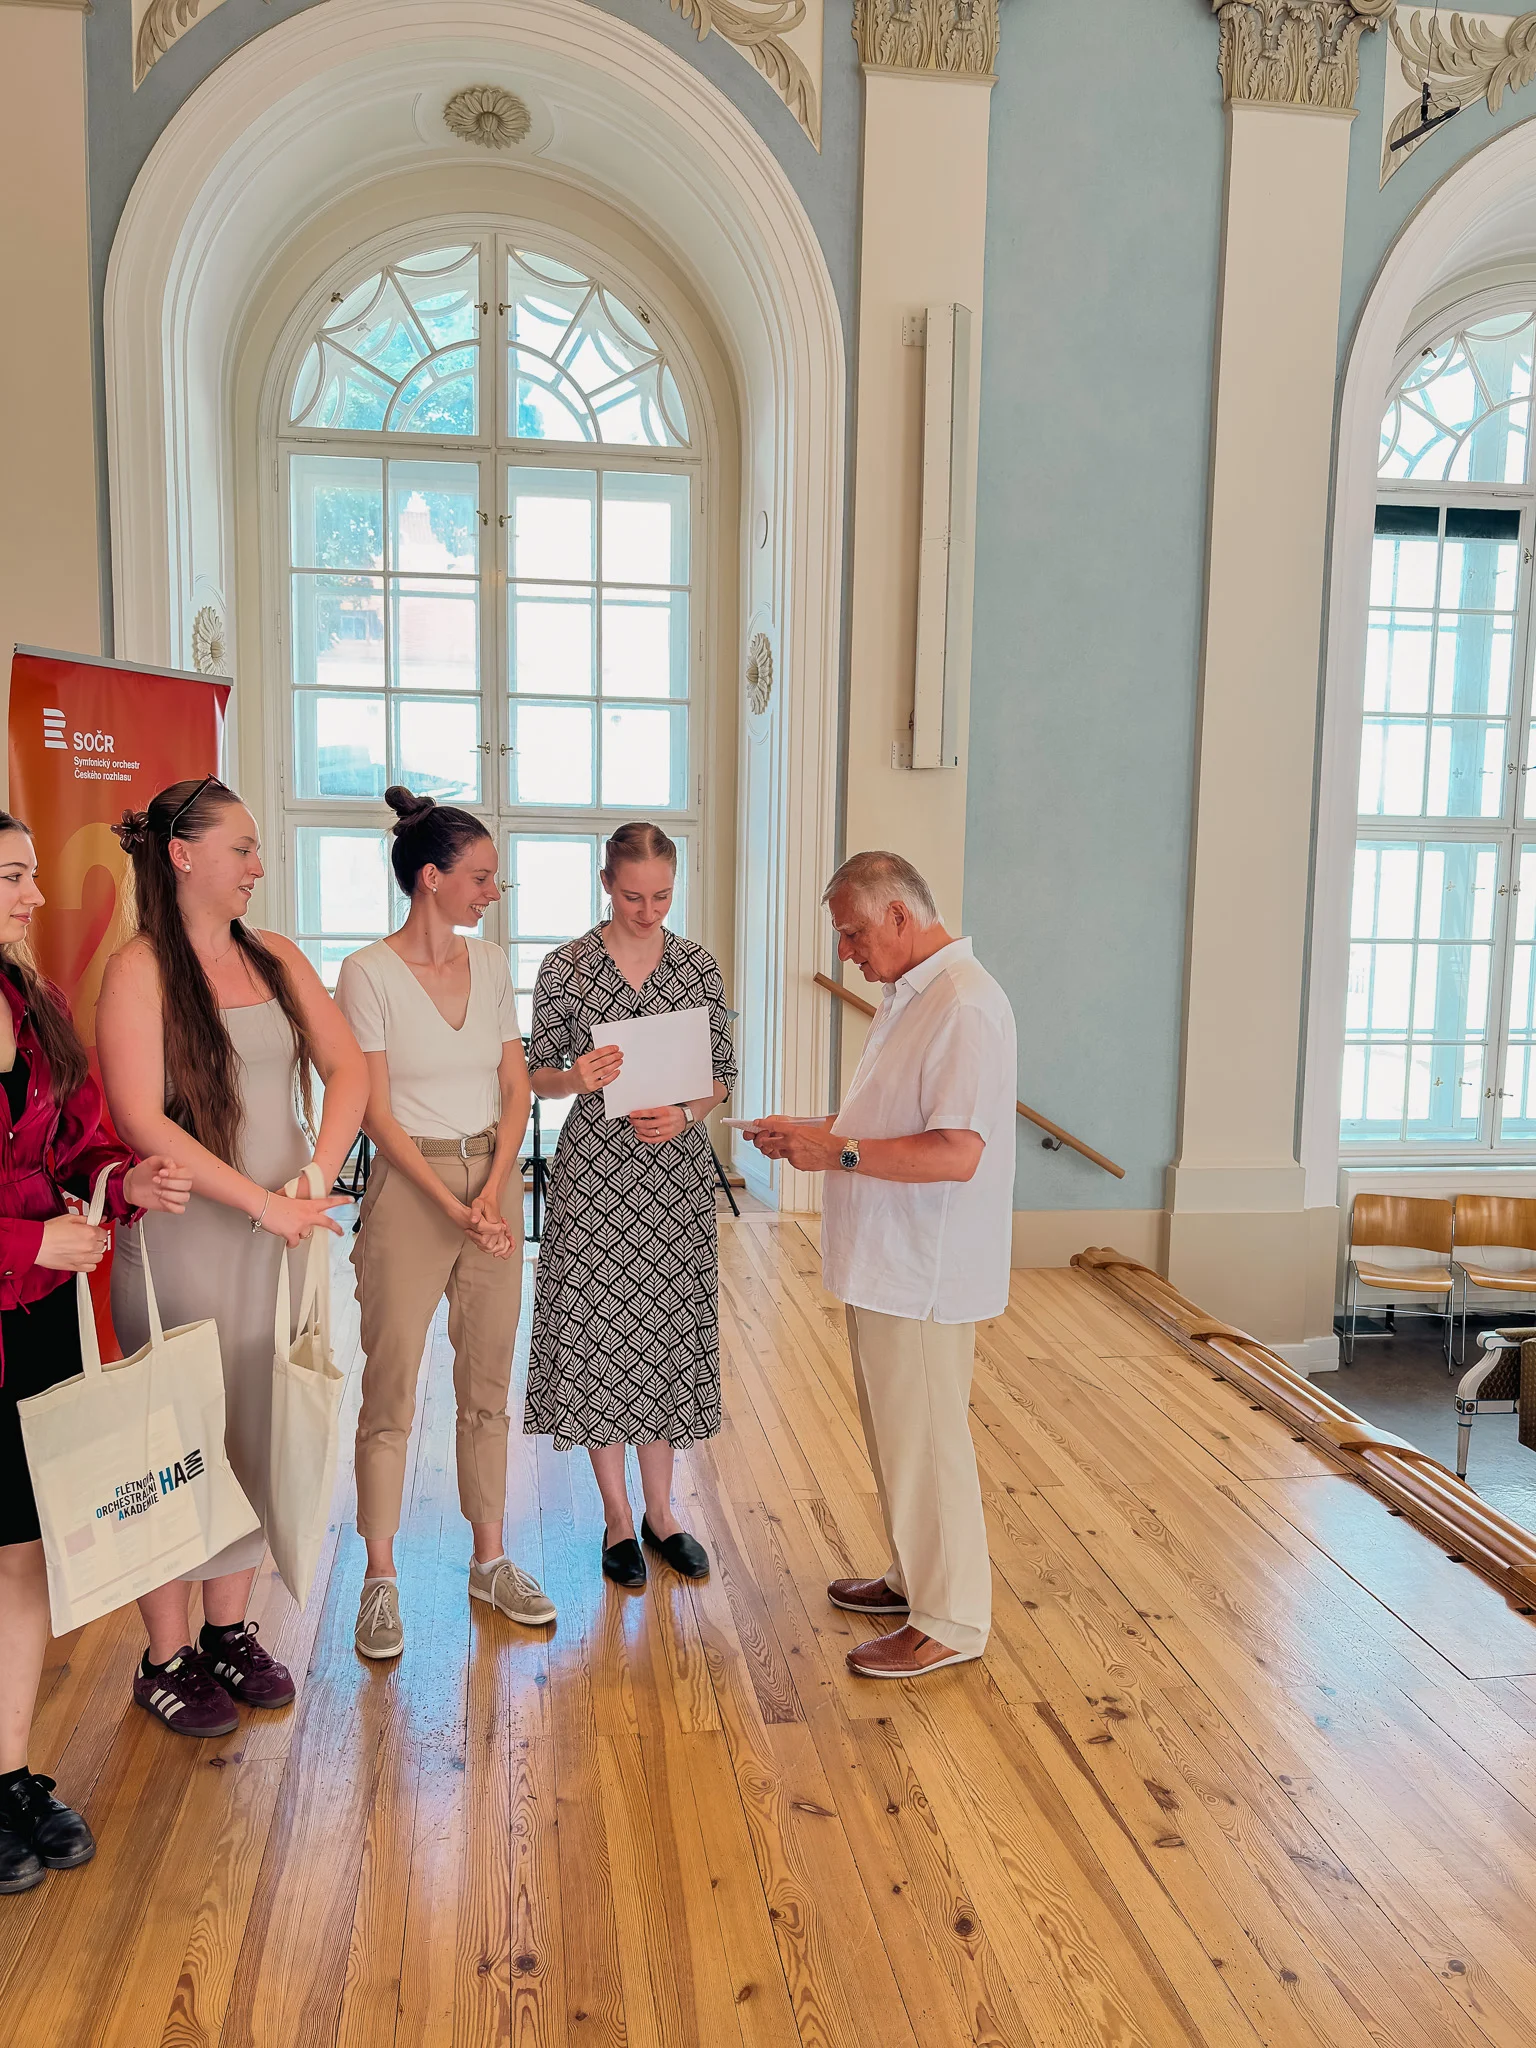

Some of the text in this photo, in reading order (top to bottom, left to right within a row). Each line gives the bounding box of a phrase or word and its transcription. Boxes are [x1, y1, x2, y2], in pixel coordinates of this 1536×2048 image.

[73, 730, 115, 753] SOČR
[73, 756, 141, 770] Symfonický orchestr
[74, 768, 132, 781] Českého rozhlasu
[118, 1492, 160, 1521] AKADEMIE
